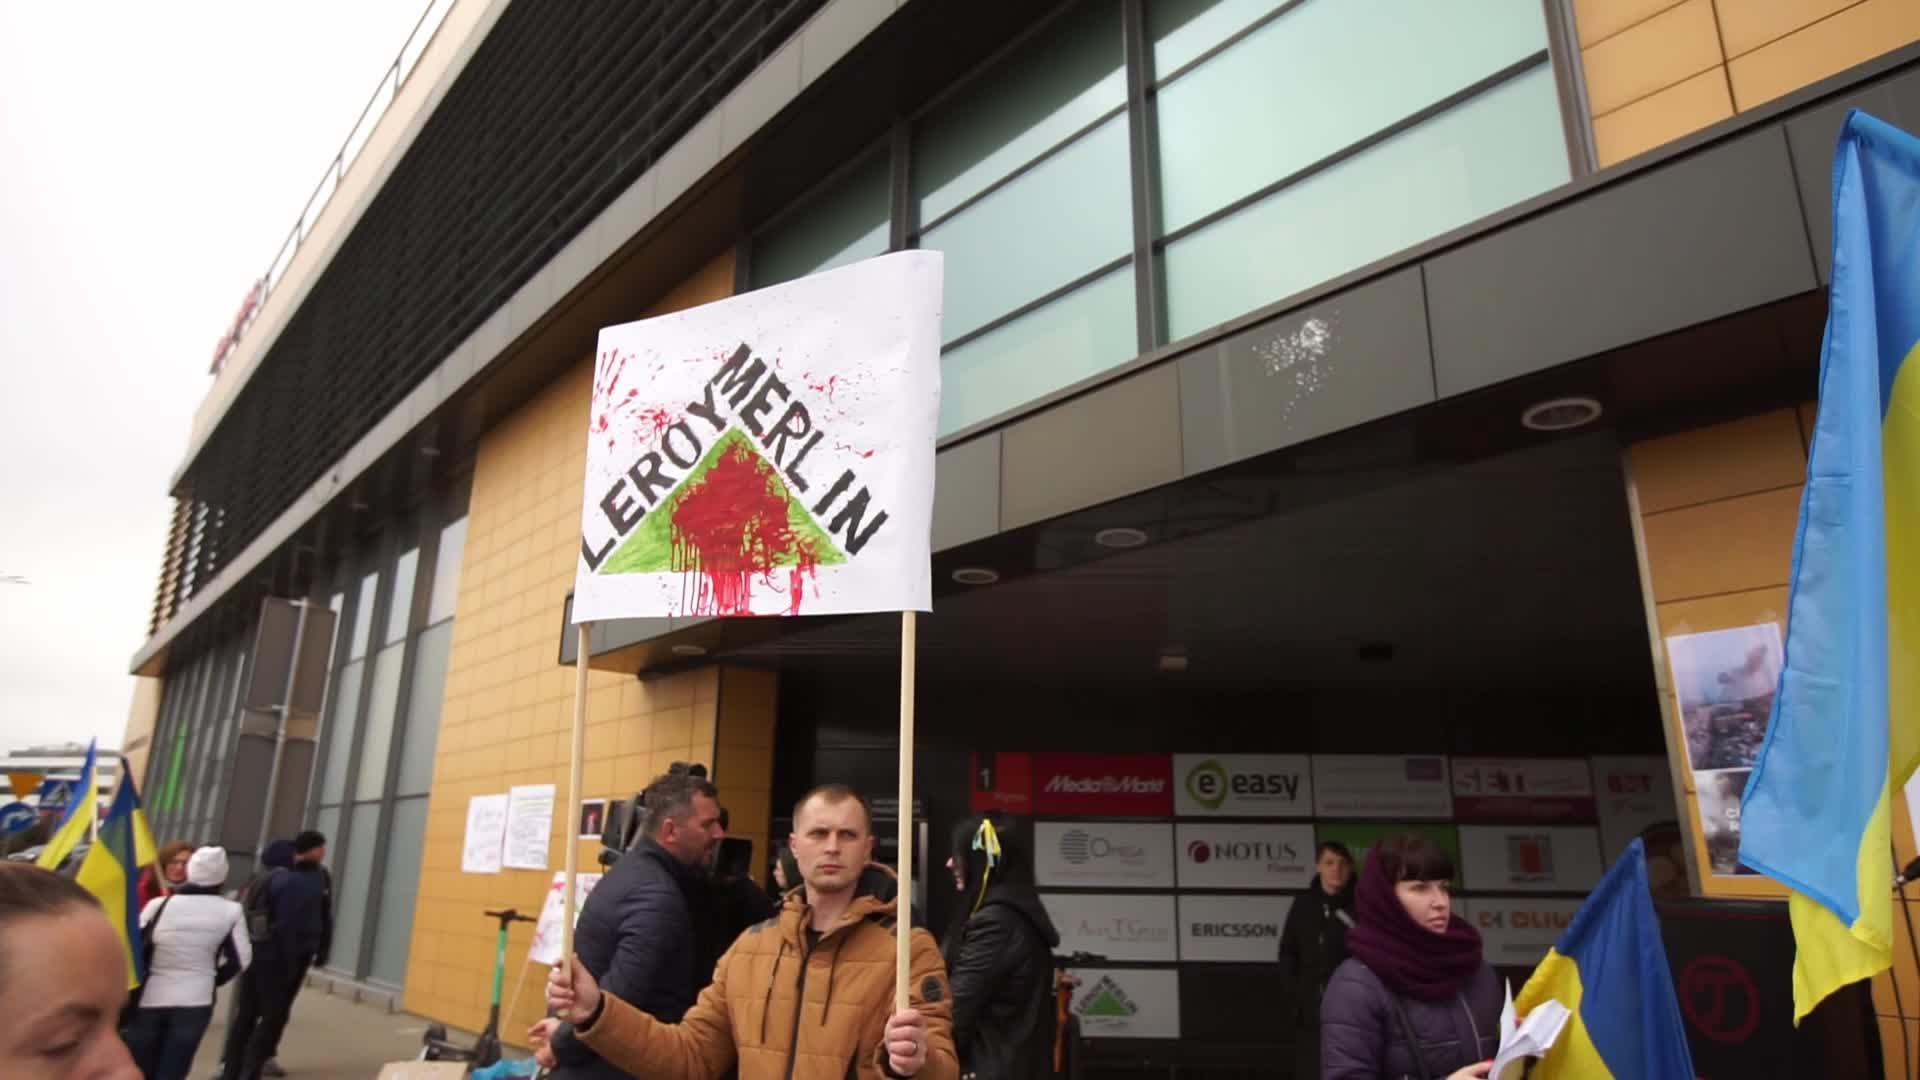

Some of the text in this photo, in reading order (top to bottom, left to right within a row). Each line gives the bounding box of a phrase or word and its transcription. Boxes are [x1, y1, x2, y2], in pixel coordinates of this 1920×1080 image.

[582, 342, 890, 571] LEROY MERLIN
[979, 767, 990, 789] 1
[1232, 774, 1299, 804] easy
[1215, 841, 1297, 862] NOTUS
[1191, 922, 1279, 938] ERICSSON
